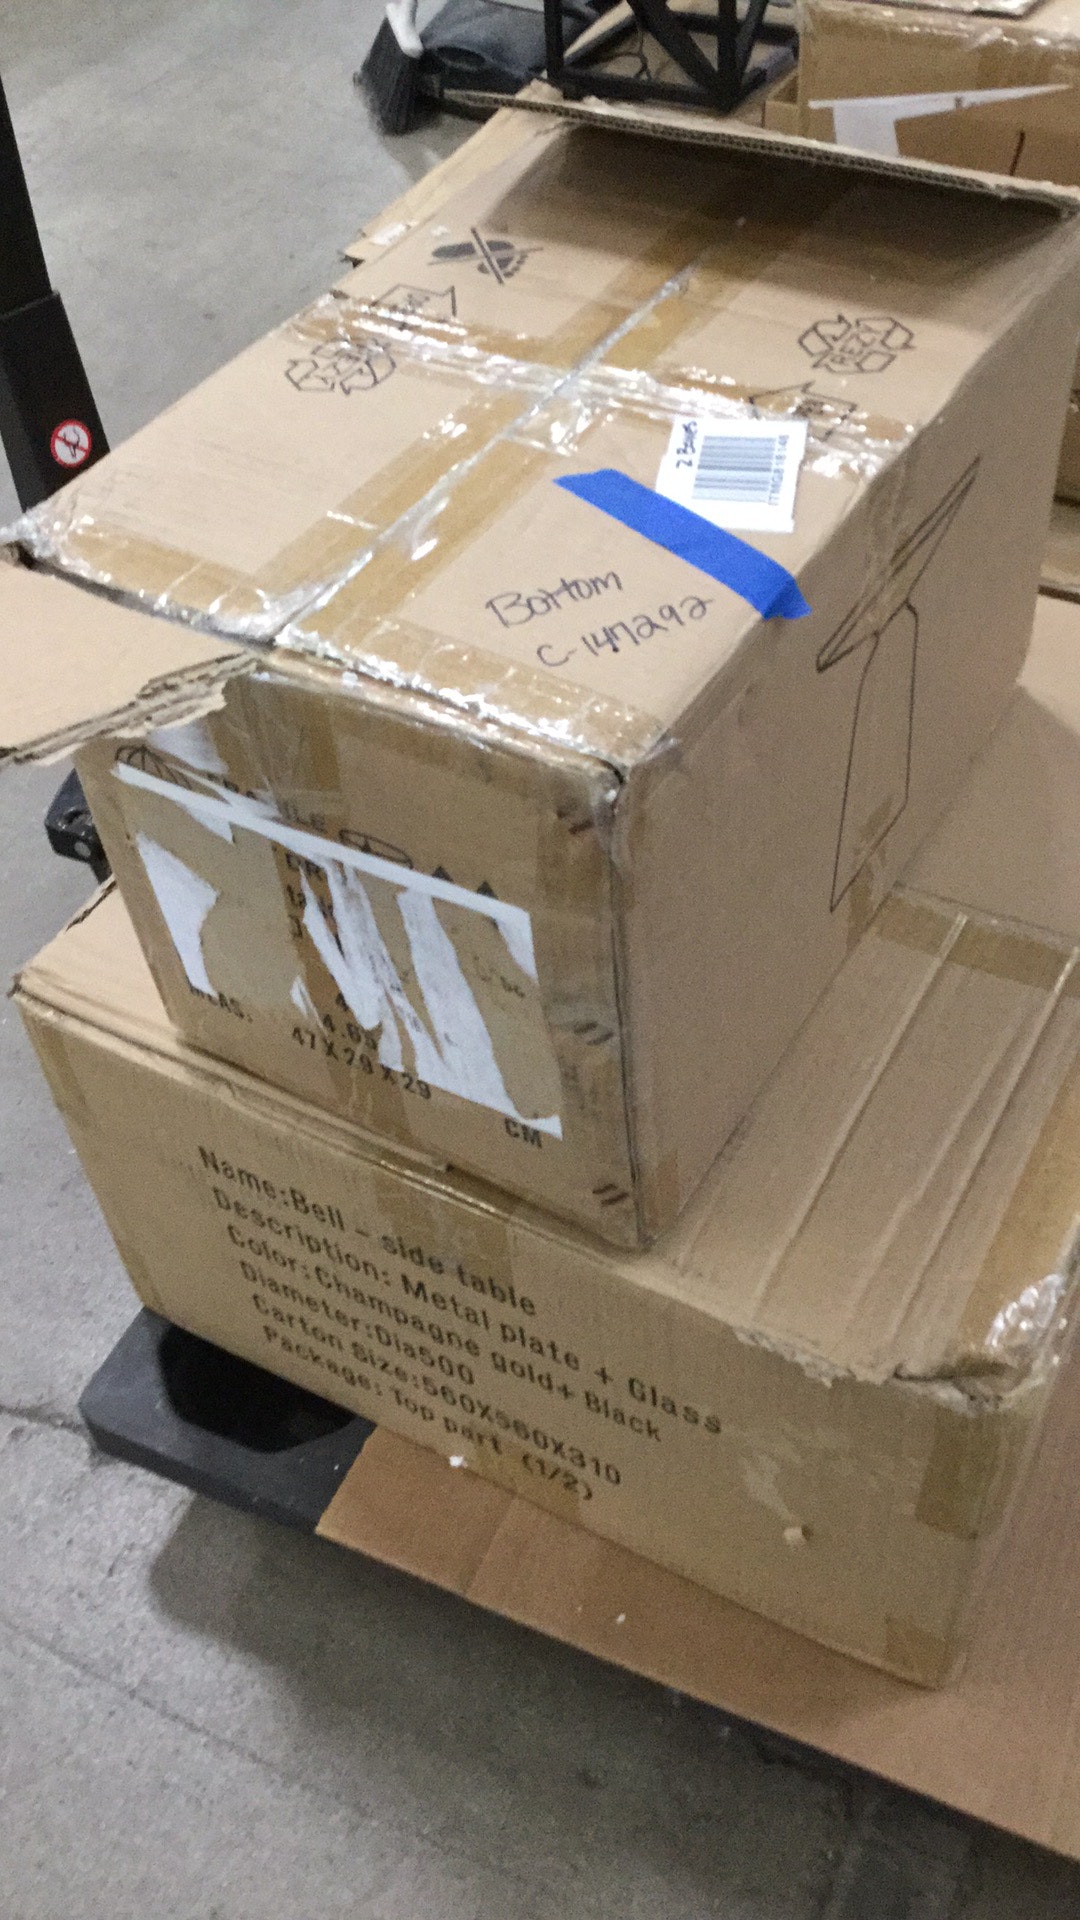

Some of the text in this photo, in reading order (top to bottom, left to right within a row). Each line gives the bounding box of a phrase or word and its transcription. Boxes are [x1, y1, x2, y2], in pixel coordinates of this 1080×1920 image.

[504, 1117, 543, 1149] CM
[199, 1145, 345, 1232] Name:Bell
[381, 1235, 445, 1275] side
[457, 1264, 536, 1317] table
[213, 1186, 391, 1286] Description:
[401, 1273, 491, 1331] Metal
[500, 1322, 579, 1371] plate
[628, 1376, 722, 1435] Glass
[252, 1293, 344, 1351] Carton
[263, 1324, 594, 1500] Package: Top part (1/2)
[584, 1389, 661, 1443] Black
